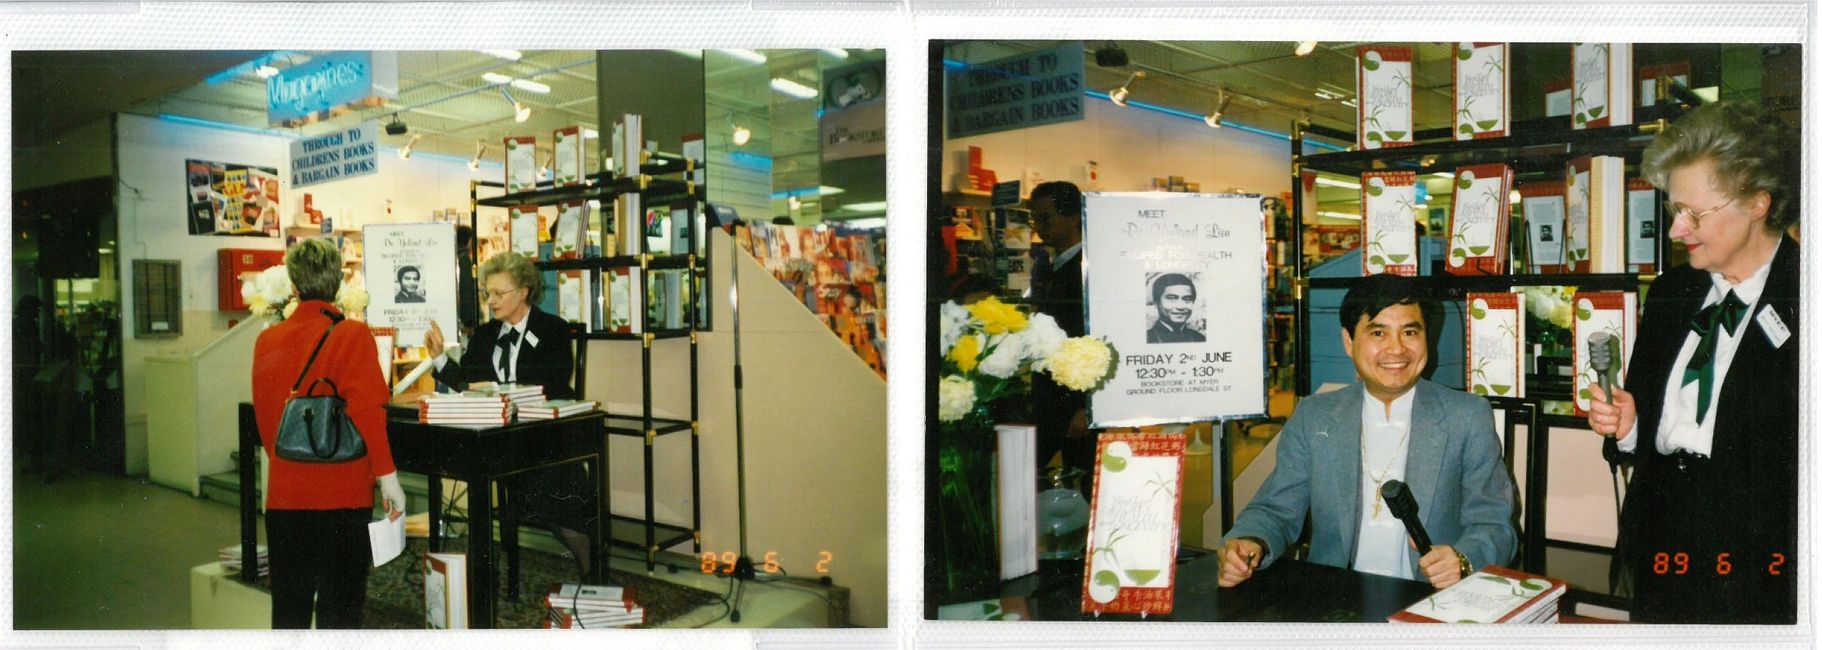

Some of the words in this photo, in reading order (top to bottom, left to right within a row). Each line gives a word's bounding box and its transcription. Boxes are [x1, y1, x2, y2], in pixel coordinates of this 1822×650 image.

[1039, 53, 1058, 72] TO
[1031, 72, 1079, 97] BOOKS
[1031, 96, 1079, 121] BOOKS
[302, 132, 343, 153] THROUGH
[348, 128, 361, 142] TO
[291, 149, 340, 170] CHILDRENS
[343, 142, 375, 160] BOOKS
[292, 174, 299, 185] &
[302, 166, 340, 183] BARGAIN
[344, 158, 375, 175] BOOKS
[1138, 209, 1166, 218] MEET
[1126, 354, 1174, 366] FRIDAY
[1201, 352, 1233, 363] JUNE
[1126, 387, 1156, 396] GROUND
[1159, 386, 1183, 394] FLOOR
[1185, 385, 1220, 394] LONSDALE
[1140, 380, 1183, 388] BOOKSTORE
